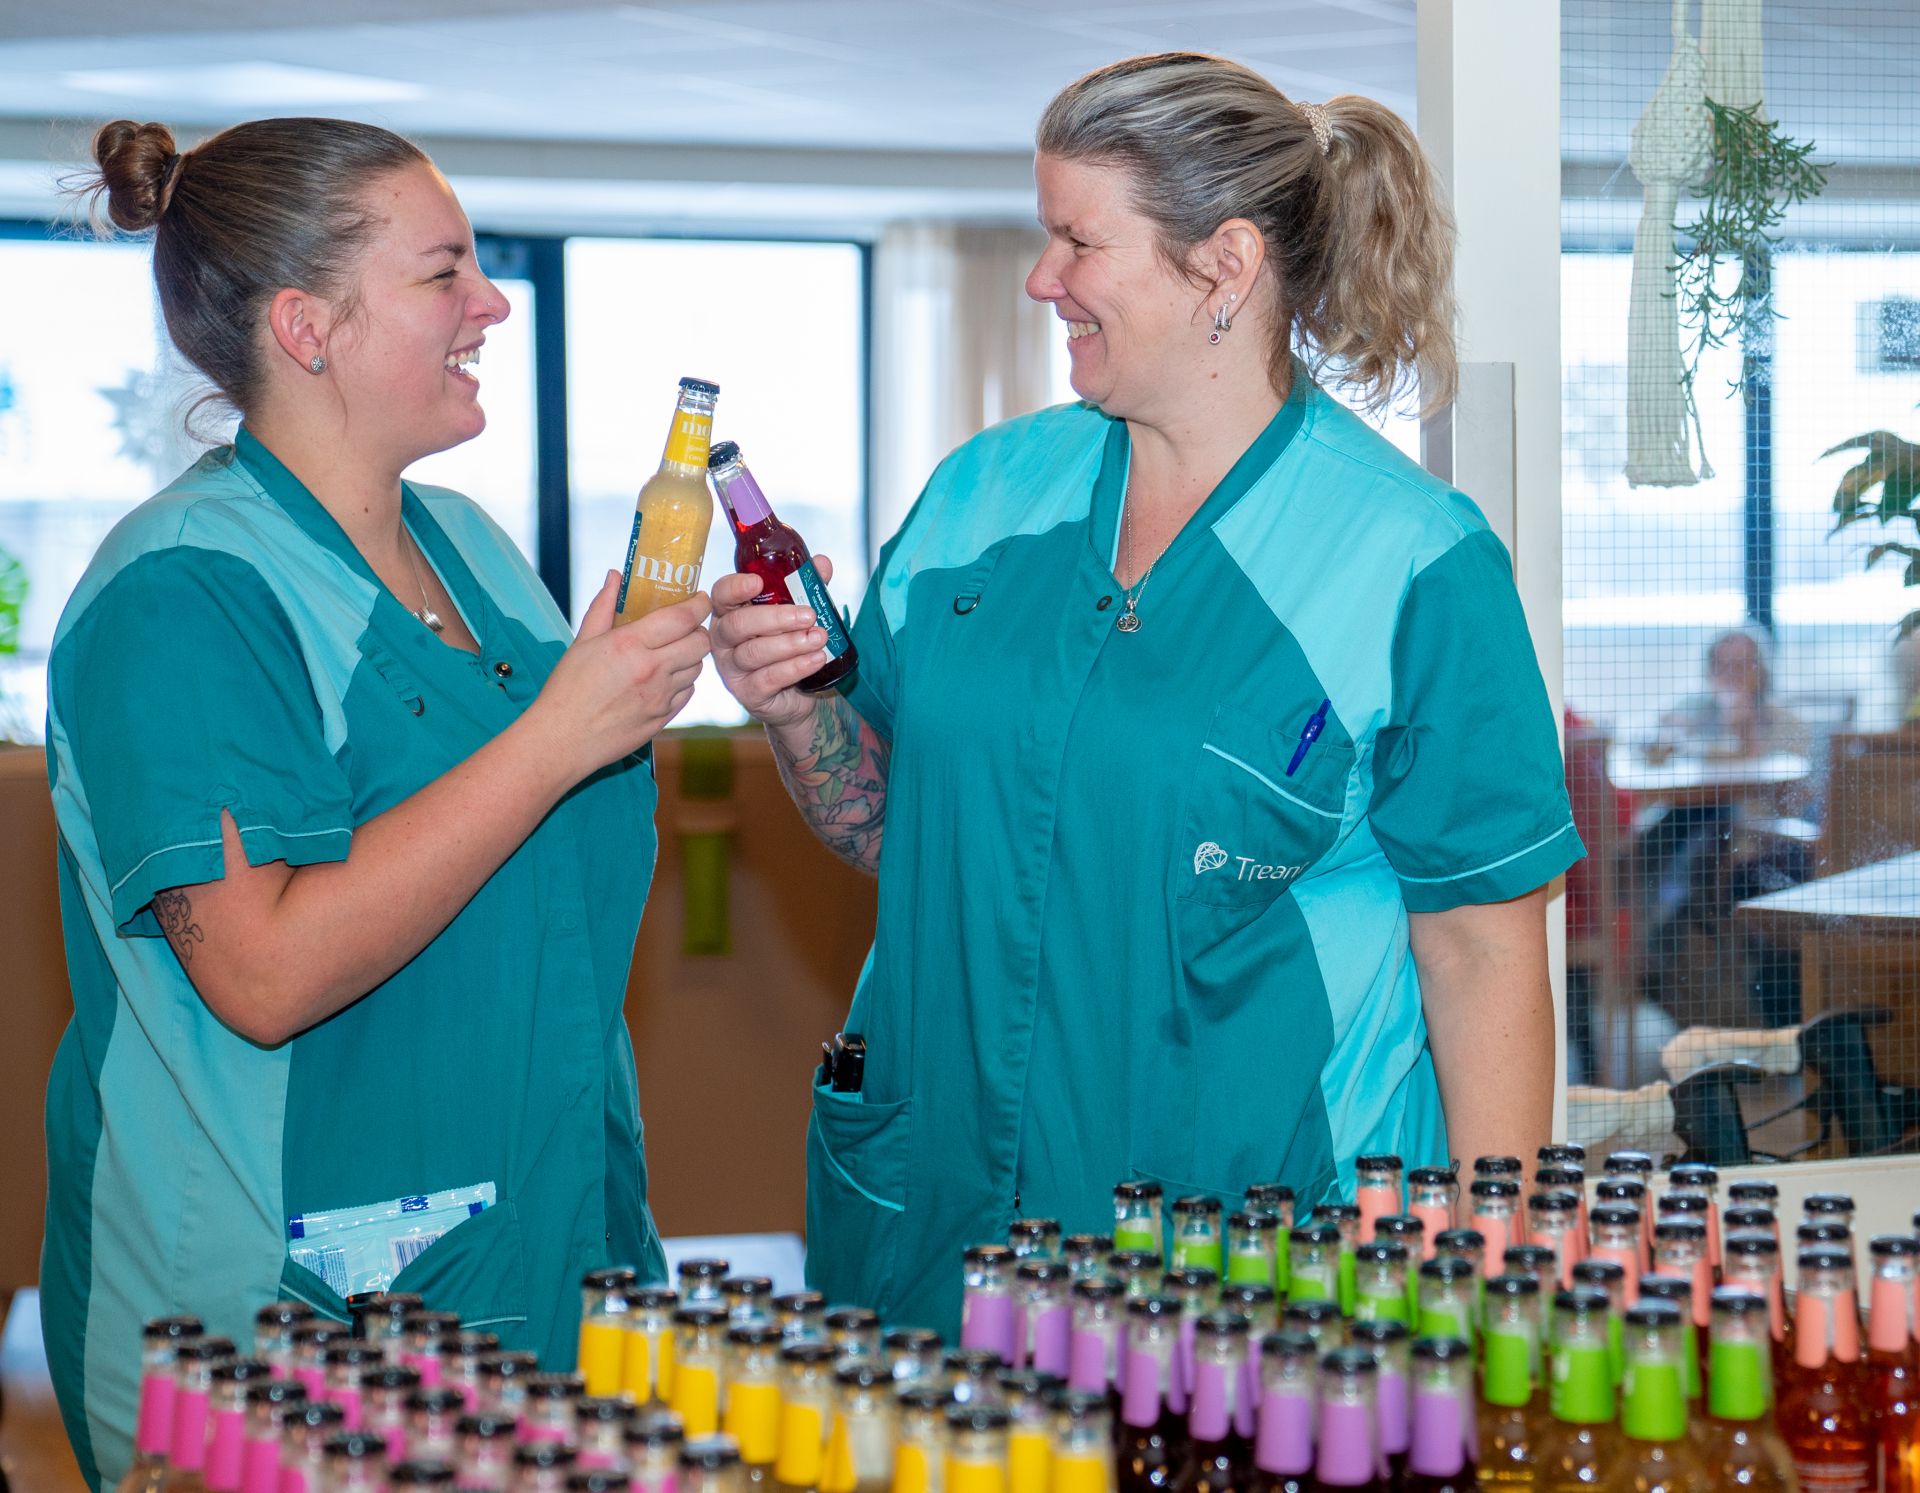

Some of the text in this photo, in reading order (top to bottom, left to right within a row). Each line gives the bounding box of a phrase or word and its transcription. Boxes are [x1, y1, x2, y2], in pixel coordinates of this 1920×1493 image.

[629, 538, 638, 563] Proost
[813, 584, 827, 608] Proost
[817, 613, 833, 632] jaar!
